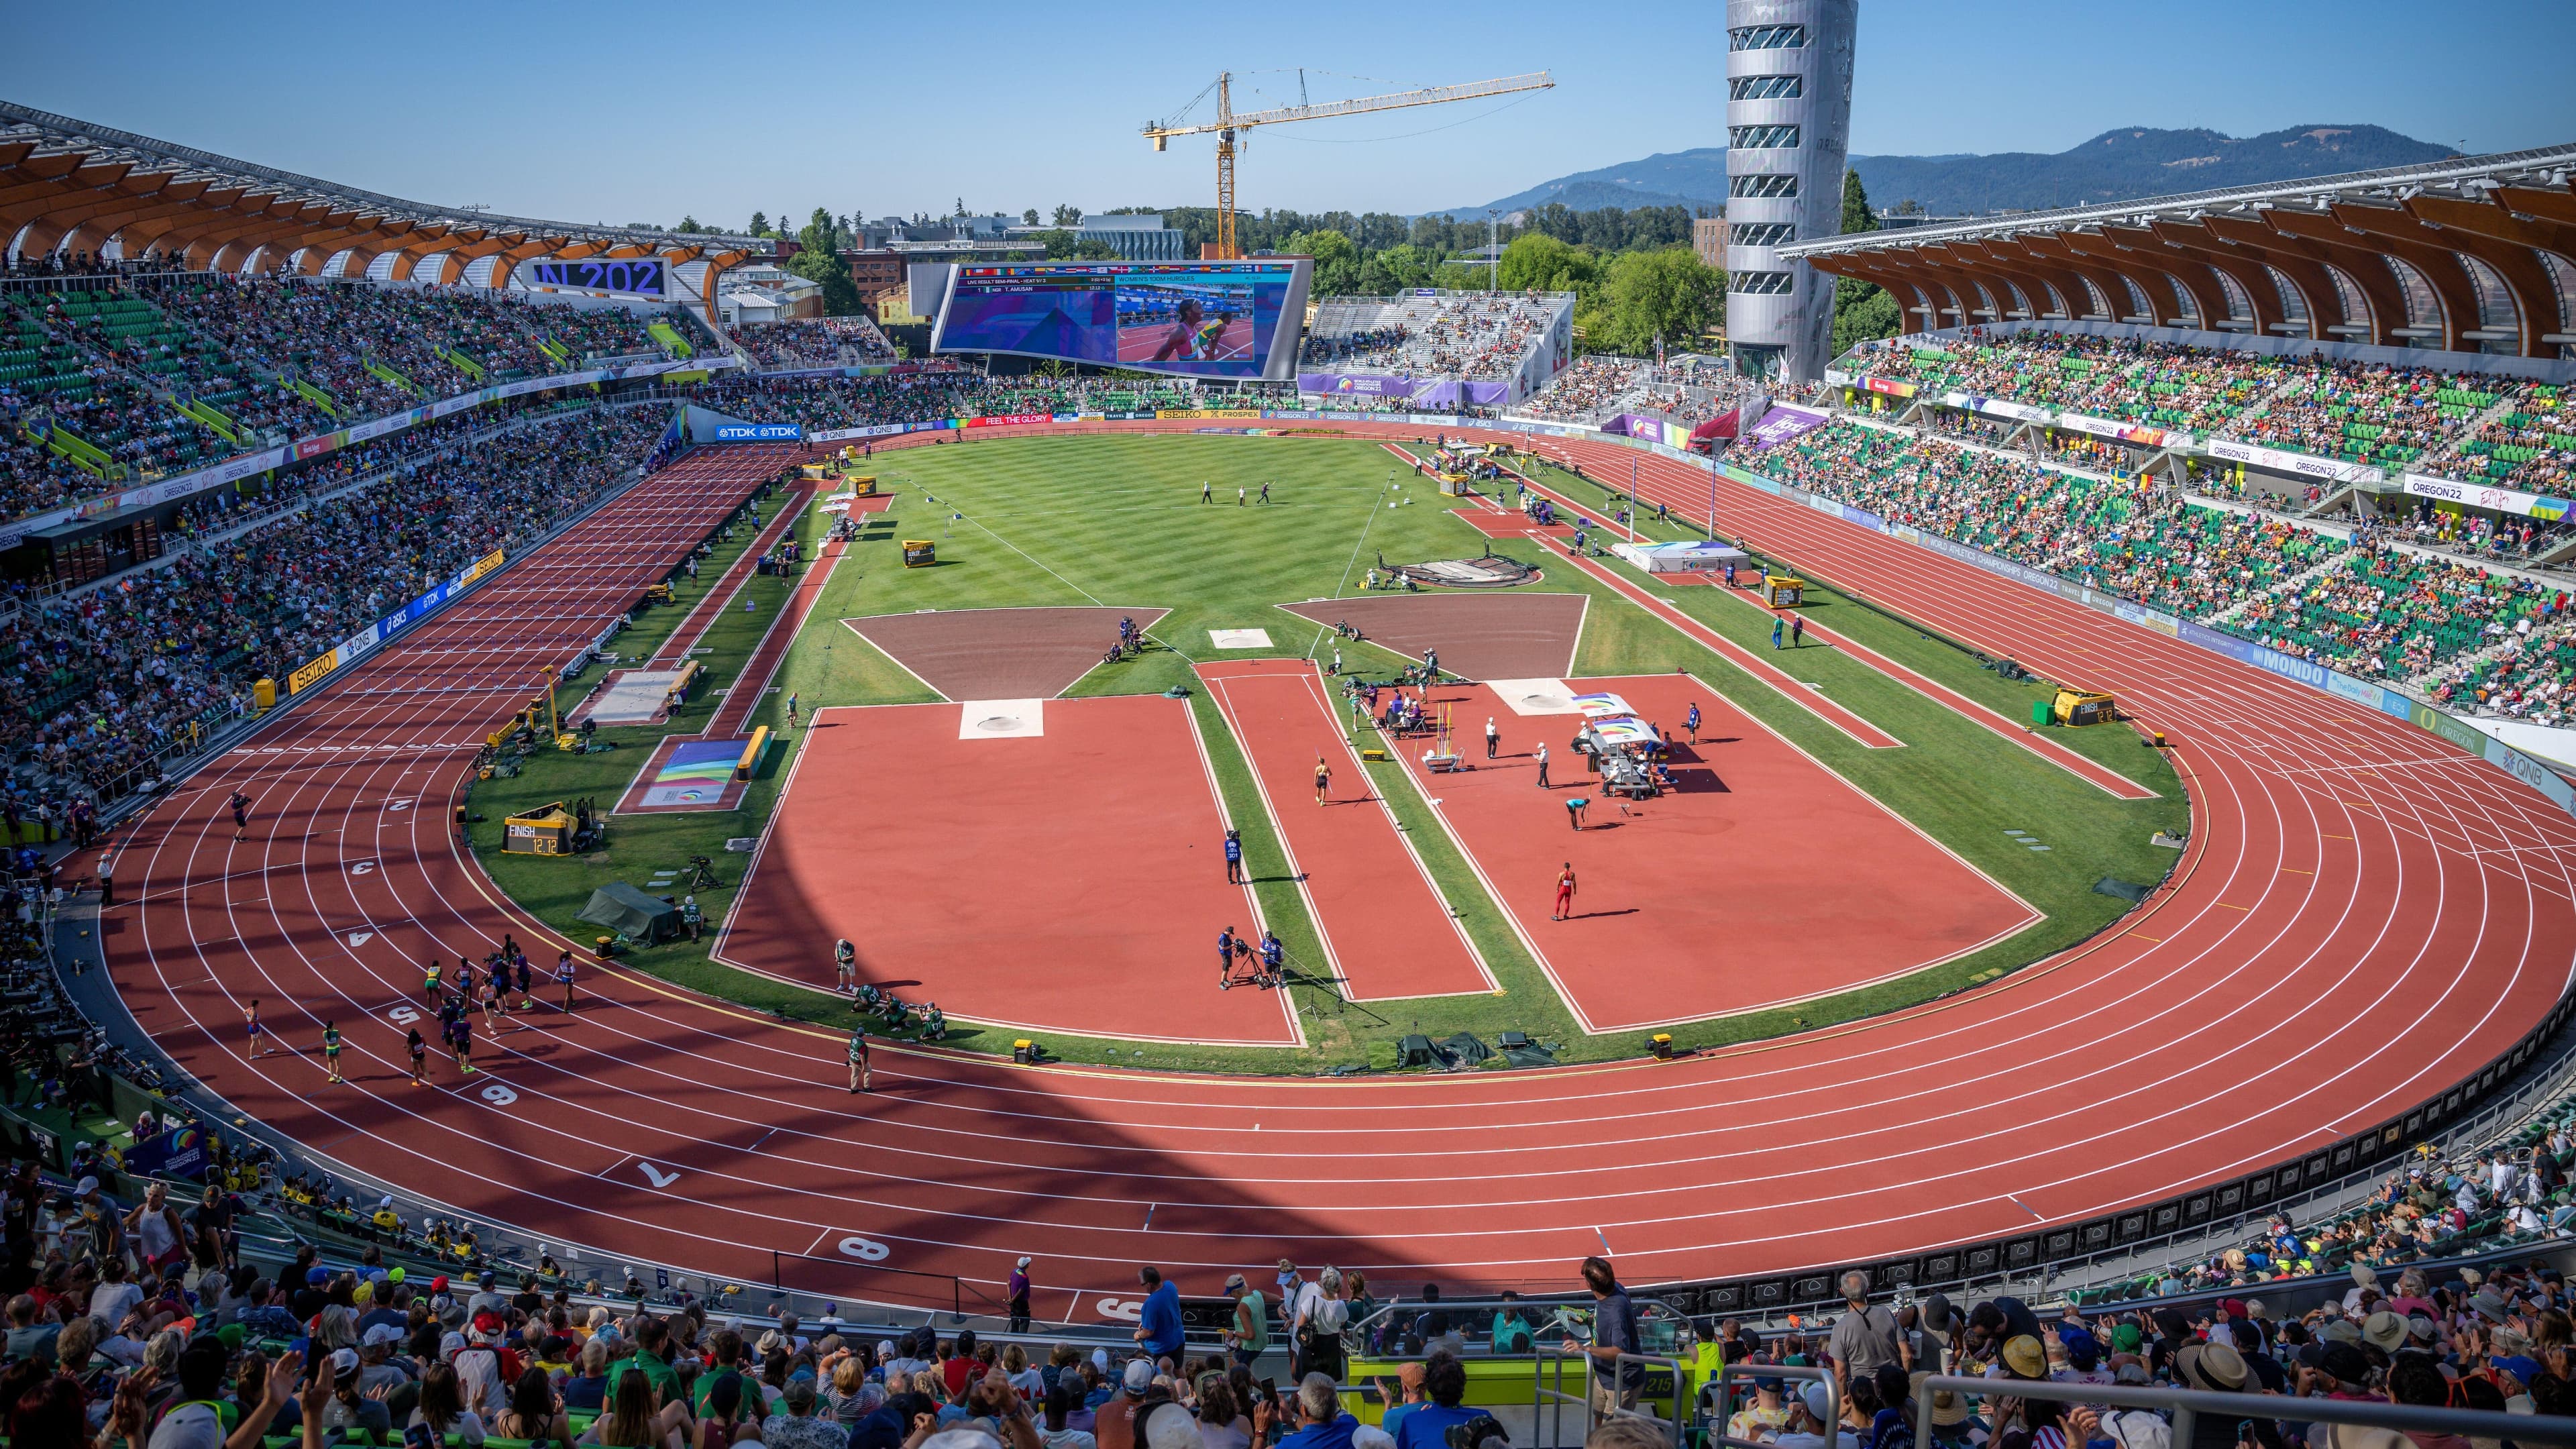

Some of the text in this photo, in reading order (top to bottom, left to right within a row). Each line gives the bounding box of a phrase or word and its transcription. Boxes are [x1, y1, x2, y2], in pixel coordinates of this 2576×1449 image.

[1022, 415, 1047, 423] GLORY
[1475, 419, 1492, 428] asics
[728, 428, 757, 437] TDK
[768, 427, 798, 437] TDK
[829, 431, 846, 439] QNB
[875, 425, 892, 434] QNB
[1519, 423, 1536, 432] asics
[1844, 509, 1860, 522] xfinity
[1862, 514, 1878, 526] xfinity
[479, 552, 500, 575] SEIKO
[1930, 538, 1947, 551] WORLD
[1949, 545, 1976, 561] ATHLETICS
[1978, 555, 2021, 577] CHAMPIONSHIPS
[427, 590, 439, 606] TDK
[2062, 586, 2113, 608] TRAVEL OREGON
[2127, 604, 2139, 612] asics
[393, 610, 407, 629] asics
[2159, 613, 2171, 623] QNB
[2149, 619, 2173, 634] SEIKO
[355, 632, 370, 650] QNB
[2189, 629, 2245, 653] ATHLETICS INTEGRITY UNIT
[297, 655, 331, 688] SEIKO
[2264, 650, 2323, 684] MONDO
[2337, 680, 2372, 699] The Daily Mile
[2081, 702, 2098, 714] FINISH
[2440, 724, 2475, 750] OREGON
[2517, 758, 2542, 786] QNB
[388, 799, 413, 811] 2
[509, 825, 535, 838] FINISH
[533, 839, 557, 854] 12.12
[351, 861, 374, 875] 3
[348, 932, 374, 947] 4
[388, 1006, 421, 1025] 5
[637, 1161, 681, 1188] 7
[838, 1236, 890, 1261] 8
[1646, 1377, 1672, 1392] 215
